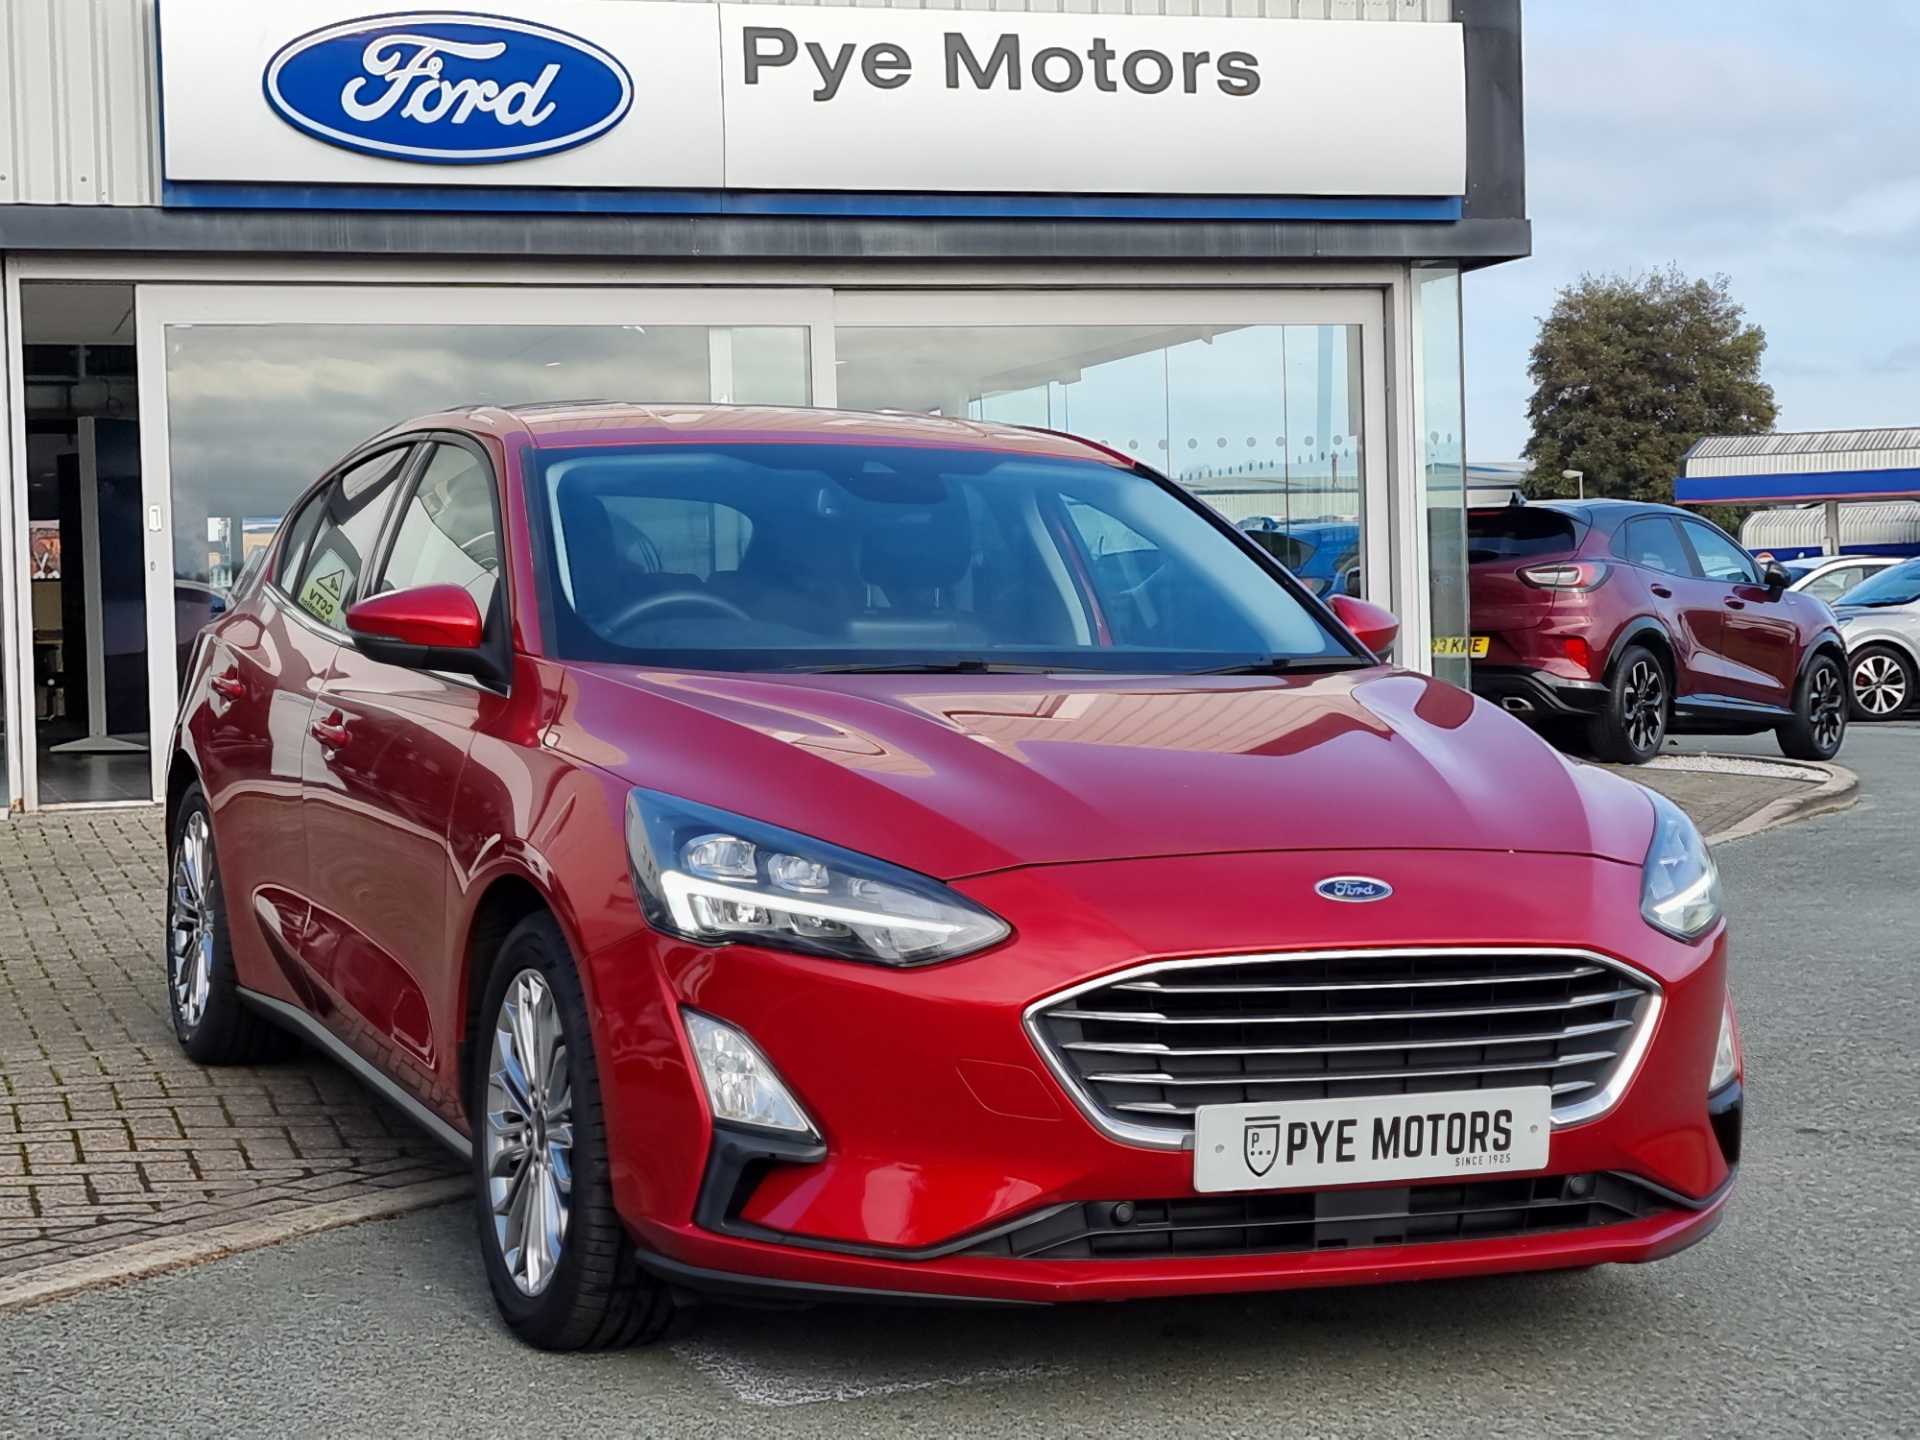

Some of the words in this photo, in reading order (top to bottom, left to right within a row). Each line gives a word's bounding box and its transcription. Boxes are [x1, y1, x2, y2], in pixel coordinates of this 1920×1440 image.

[341, 33, 561, 127] Ford
[743, 26, 912, 101] Pye
[944, 32, 1261, 96] Motors
[1334, 880, 1376, 896] Ford
[1286, 1118, 1358, 1166] PYE
[1372, 1109, 1513, 1161] MOTORS
[1455, 1155, 1483, 1168] SINCE
[1488, 1153, 1512, 1165] 1925
